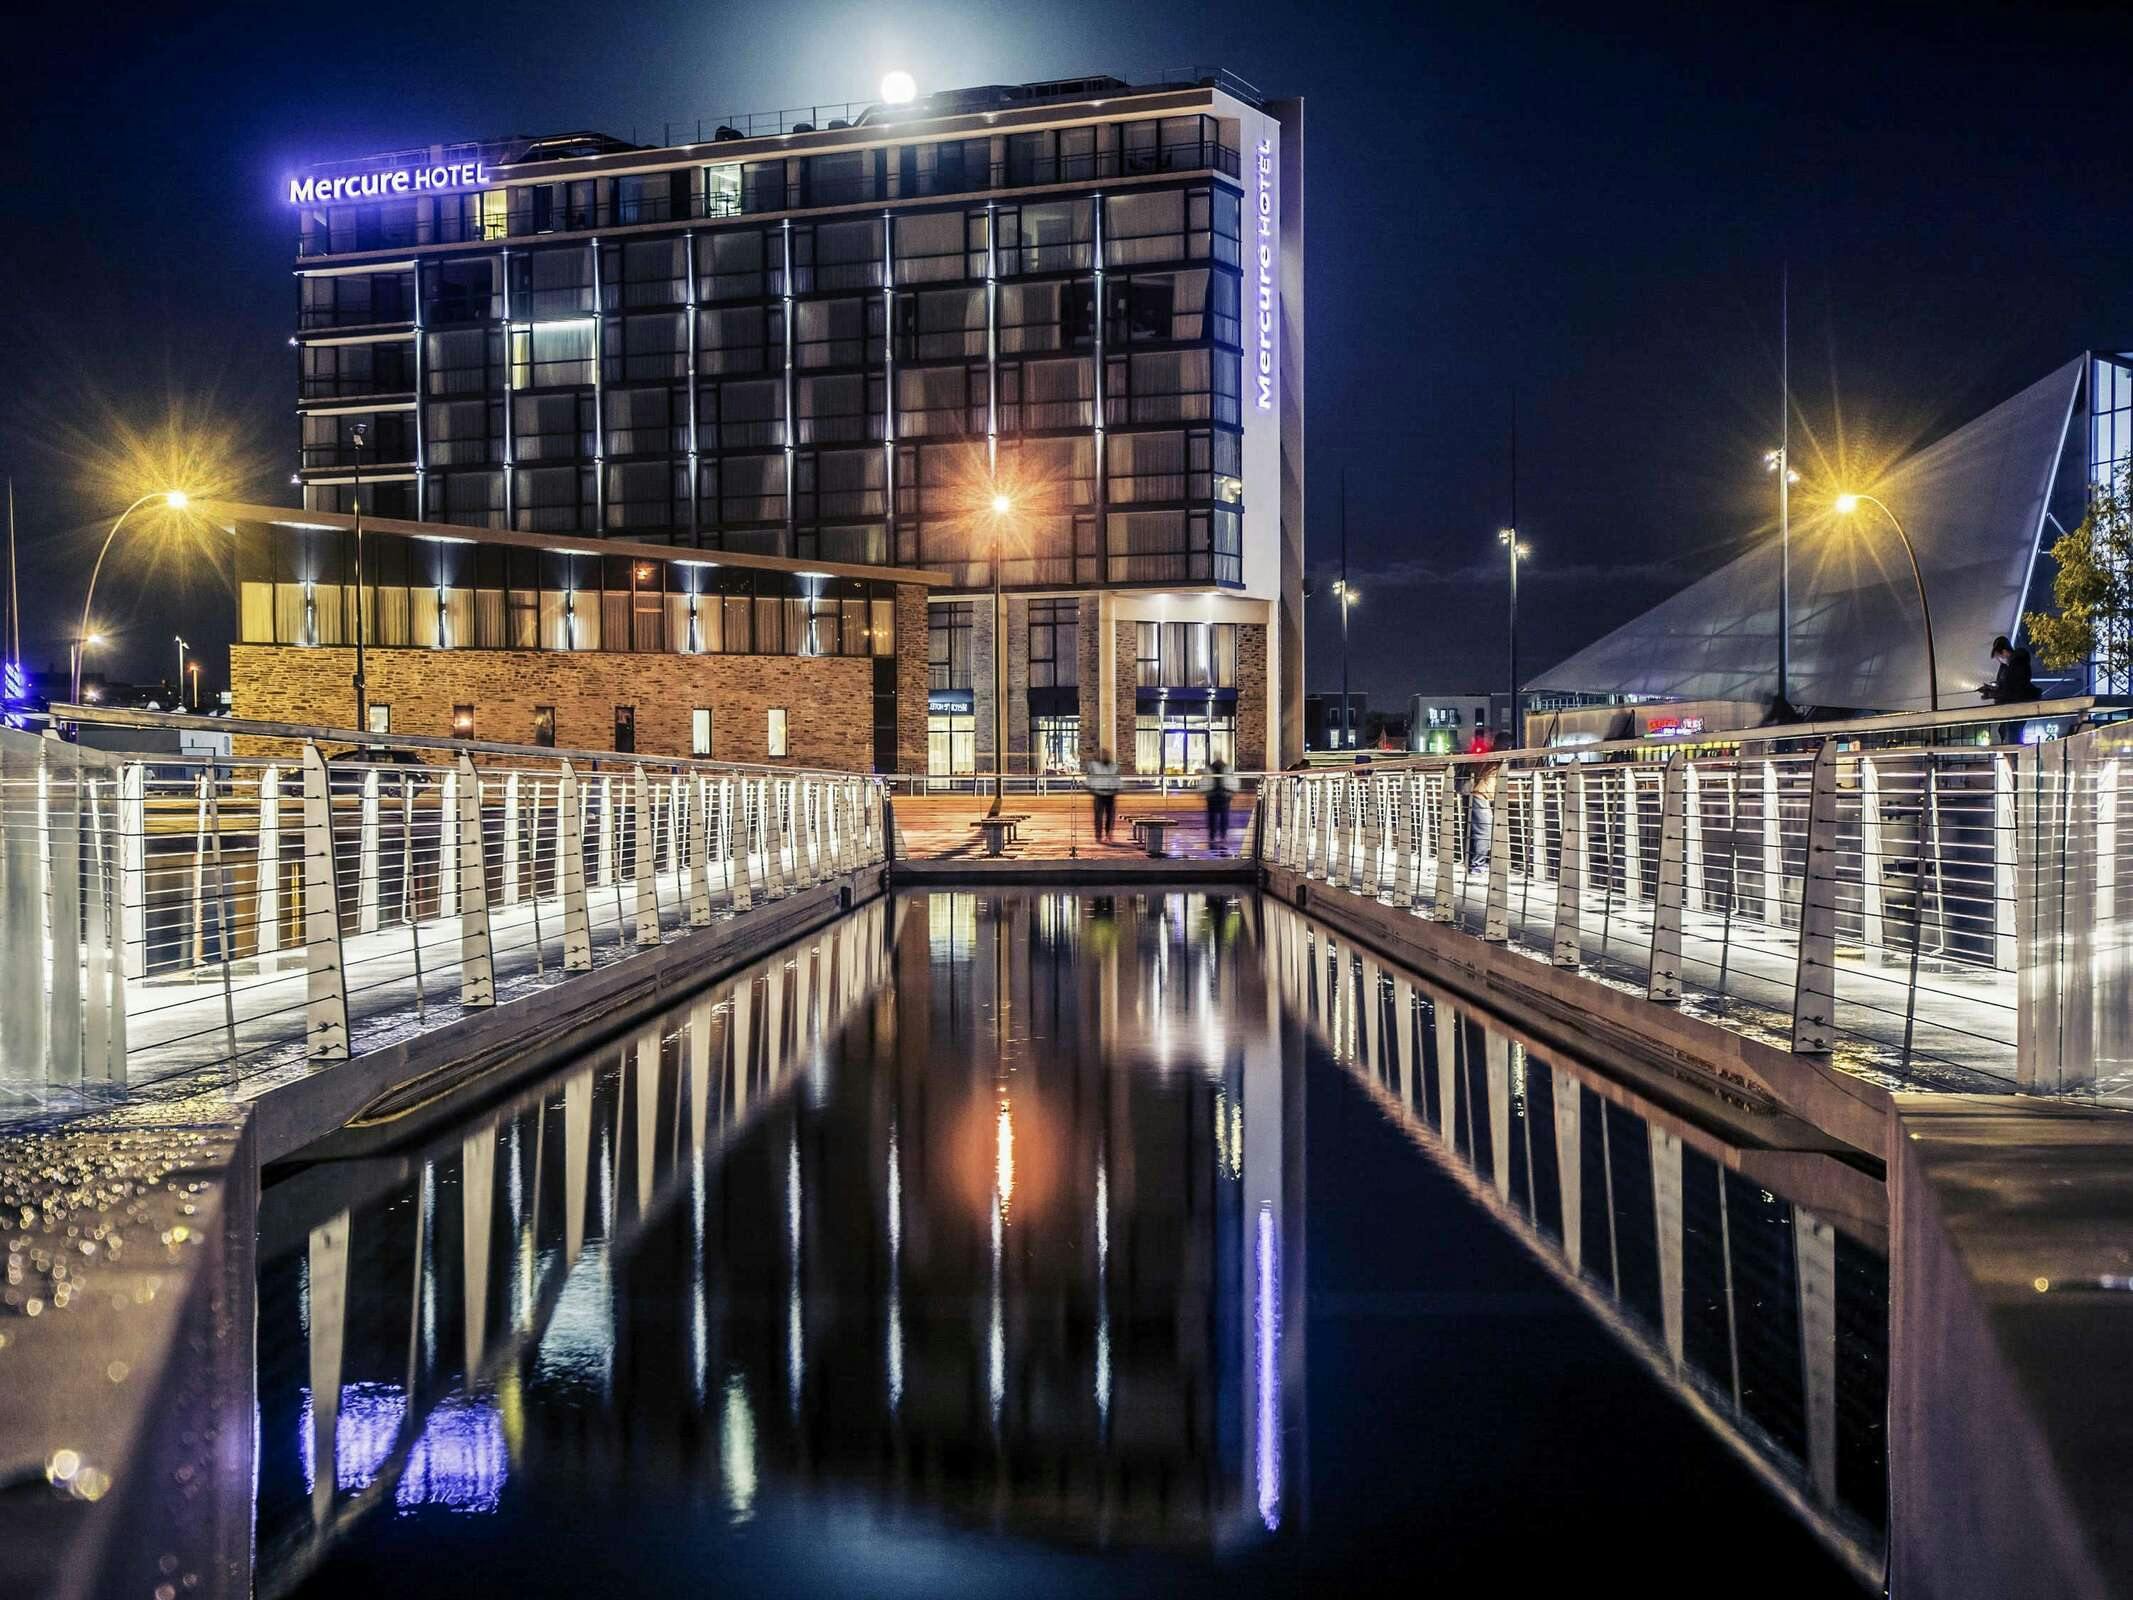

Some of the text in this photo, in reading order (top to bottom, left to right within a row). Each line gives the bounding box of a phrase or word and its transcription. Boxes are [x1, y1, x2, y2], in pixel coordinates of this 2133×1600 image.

[289, 163, 489, 204] Mercure HOTEL
[1256, 138, 1272, 410] Mercure HOTEL
